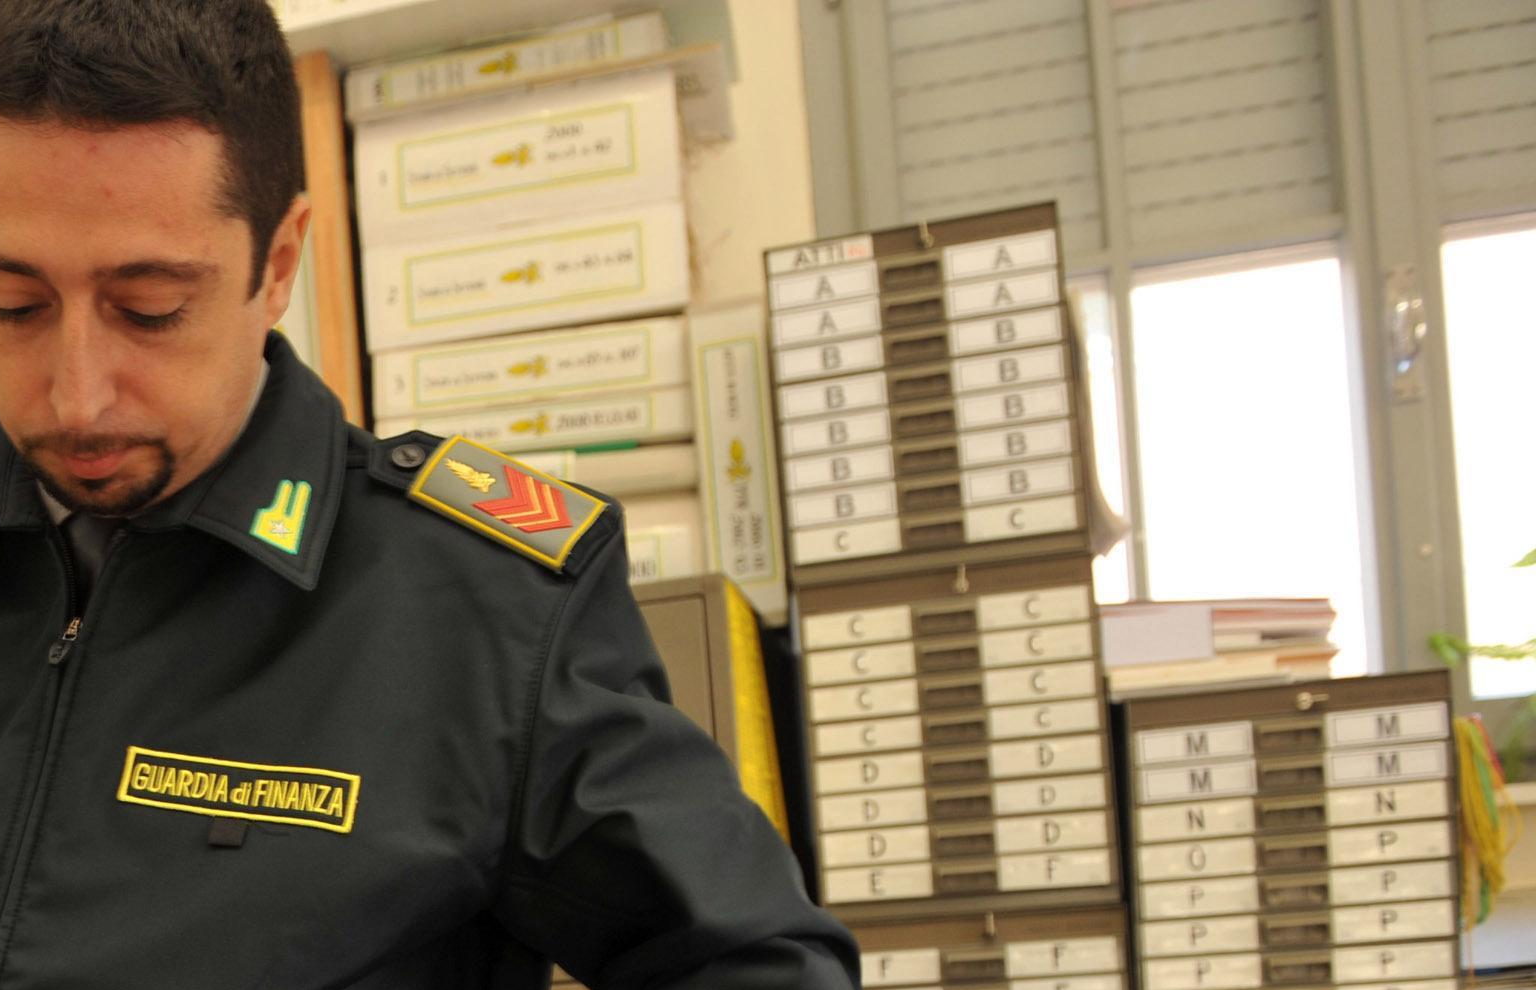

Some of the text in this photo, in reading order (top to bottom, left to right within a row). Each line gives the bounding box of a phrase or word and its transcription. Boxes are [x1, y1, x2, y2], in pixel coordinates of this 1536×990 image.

[993, 245, 1013, 268] A
[816, 276, 834, 296] A
[995, 284, 1013, 305] A
[818, 313, 837, 333] A
[997, 320, 1015, 343] B
[822, 348, 840, 368] B
[1000, 359, 1018, 382] B
[826, 386, 844, 408] B
[1005, 395, 1023, 418] B
[829, 422, 847, 444] B
[1007, 433, 1026, 455] B
[832, 458, 851, 480] B
[1009, 470, 1028, 492] B
[836, 496, 854, 516] B
[1377, 715, 1400, 736] M
[1187, 734, 1208, 755] M
[1377, 755, 1400, 775] M
[131, 763, 343, 817] GUARDIA di FINANZA
[1191, 771, 1212, 792] M
[1376, 792, 1396, 813] N
[1188, 810, 1206, 829] N
[1380, 832, 1398, 852] P
[1189, 849, 1206, 871] O
[1382, 871, 1396, 890] P
[1190, 888, 1204, 906] P
[1381, 911, 1397, 931] P
[1190, 927, 1206, 946] P
[1196, 963, 1211, 983] P
[1382, 953, 1395, 972] P
